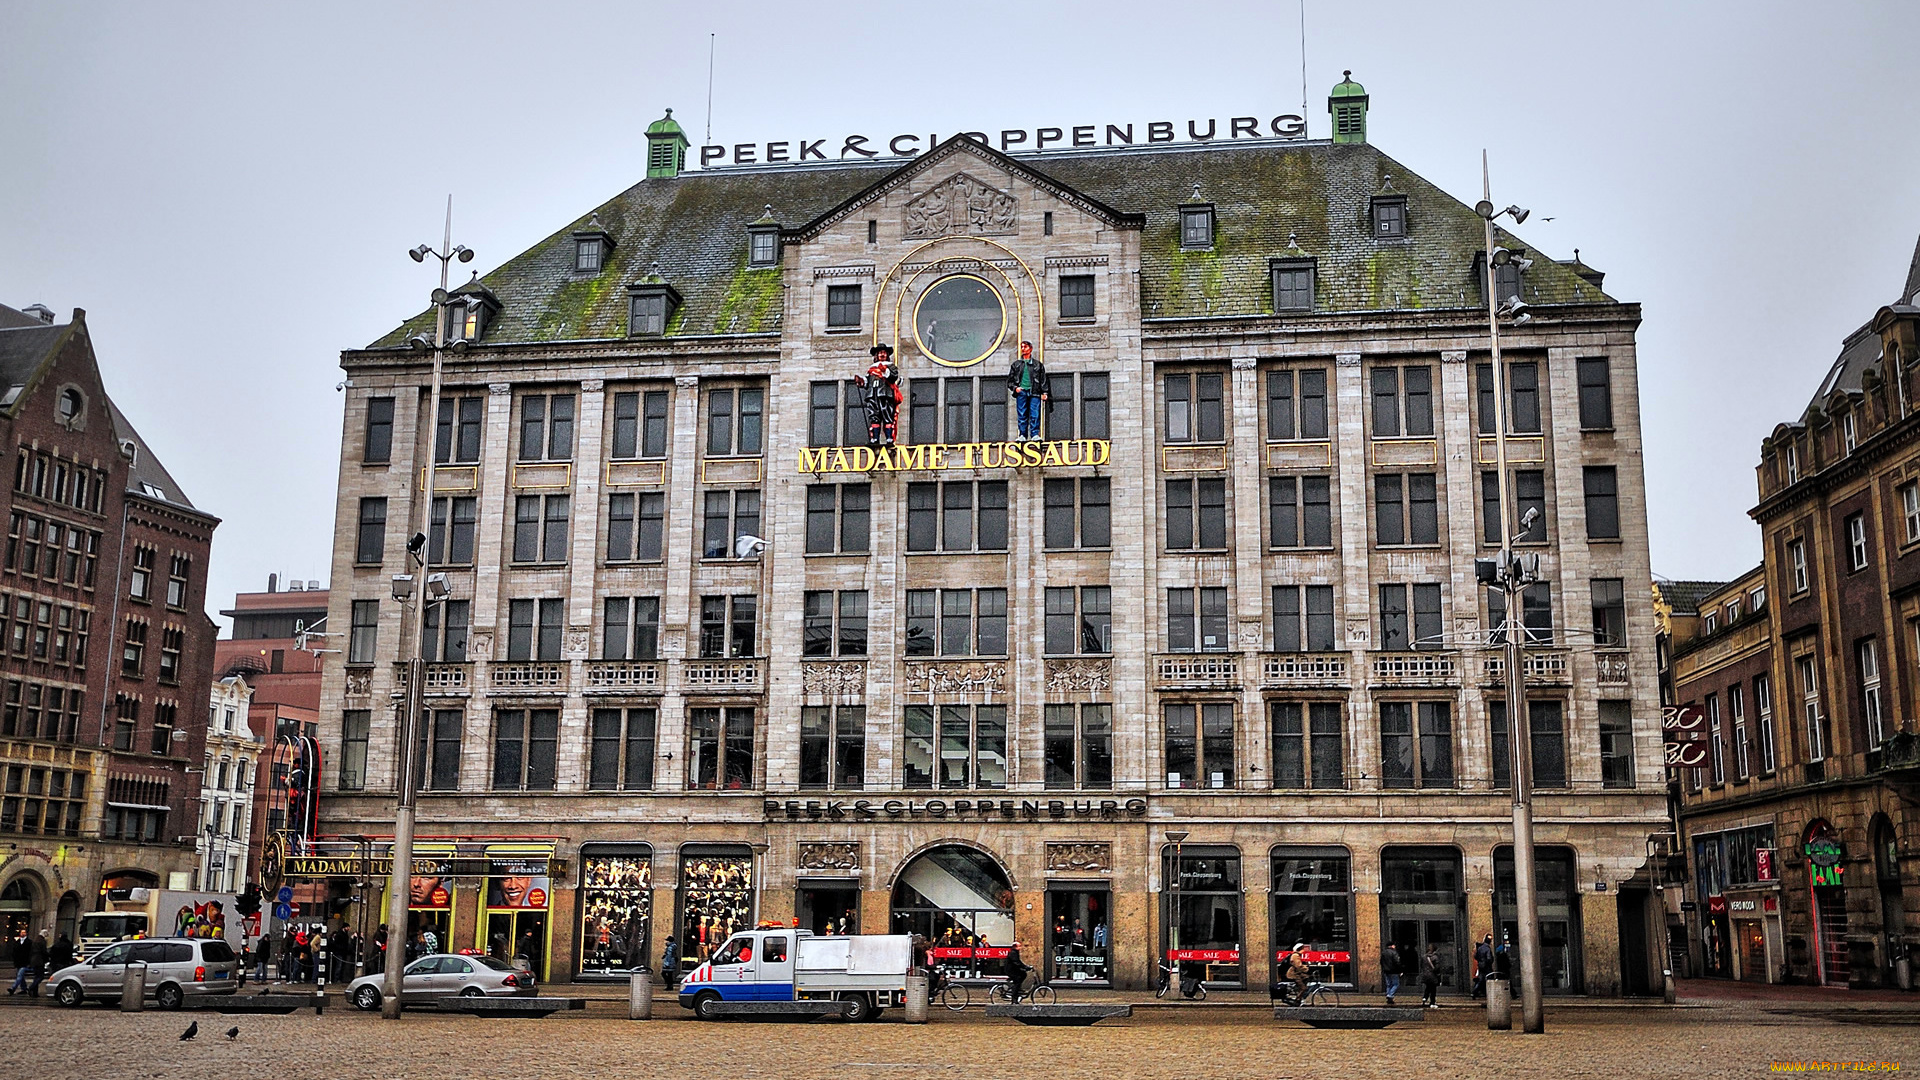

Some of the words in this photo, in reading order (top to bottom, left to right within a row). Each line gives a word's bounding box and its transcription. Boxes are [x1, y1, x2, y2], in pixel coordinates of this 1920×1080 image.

[700, 139, 828, 167] PEEK
[799, 445, 948, 472] MADAME
[957, 439, 1110, 468] TUSSAUD
[763, 800, 846, 816] PEEK
[883, 799, 1147, 815] CLOPPENBURG
[293, 860, 361, 874] MADAME
[508, 865, 548, 874] debate?
[1203, 951, 1220, 959] SALE
[1320, 952, 1337, 960] SALE
